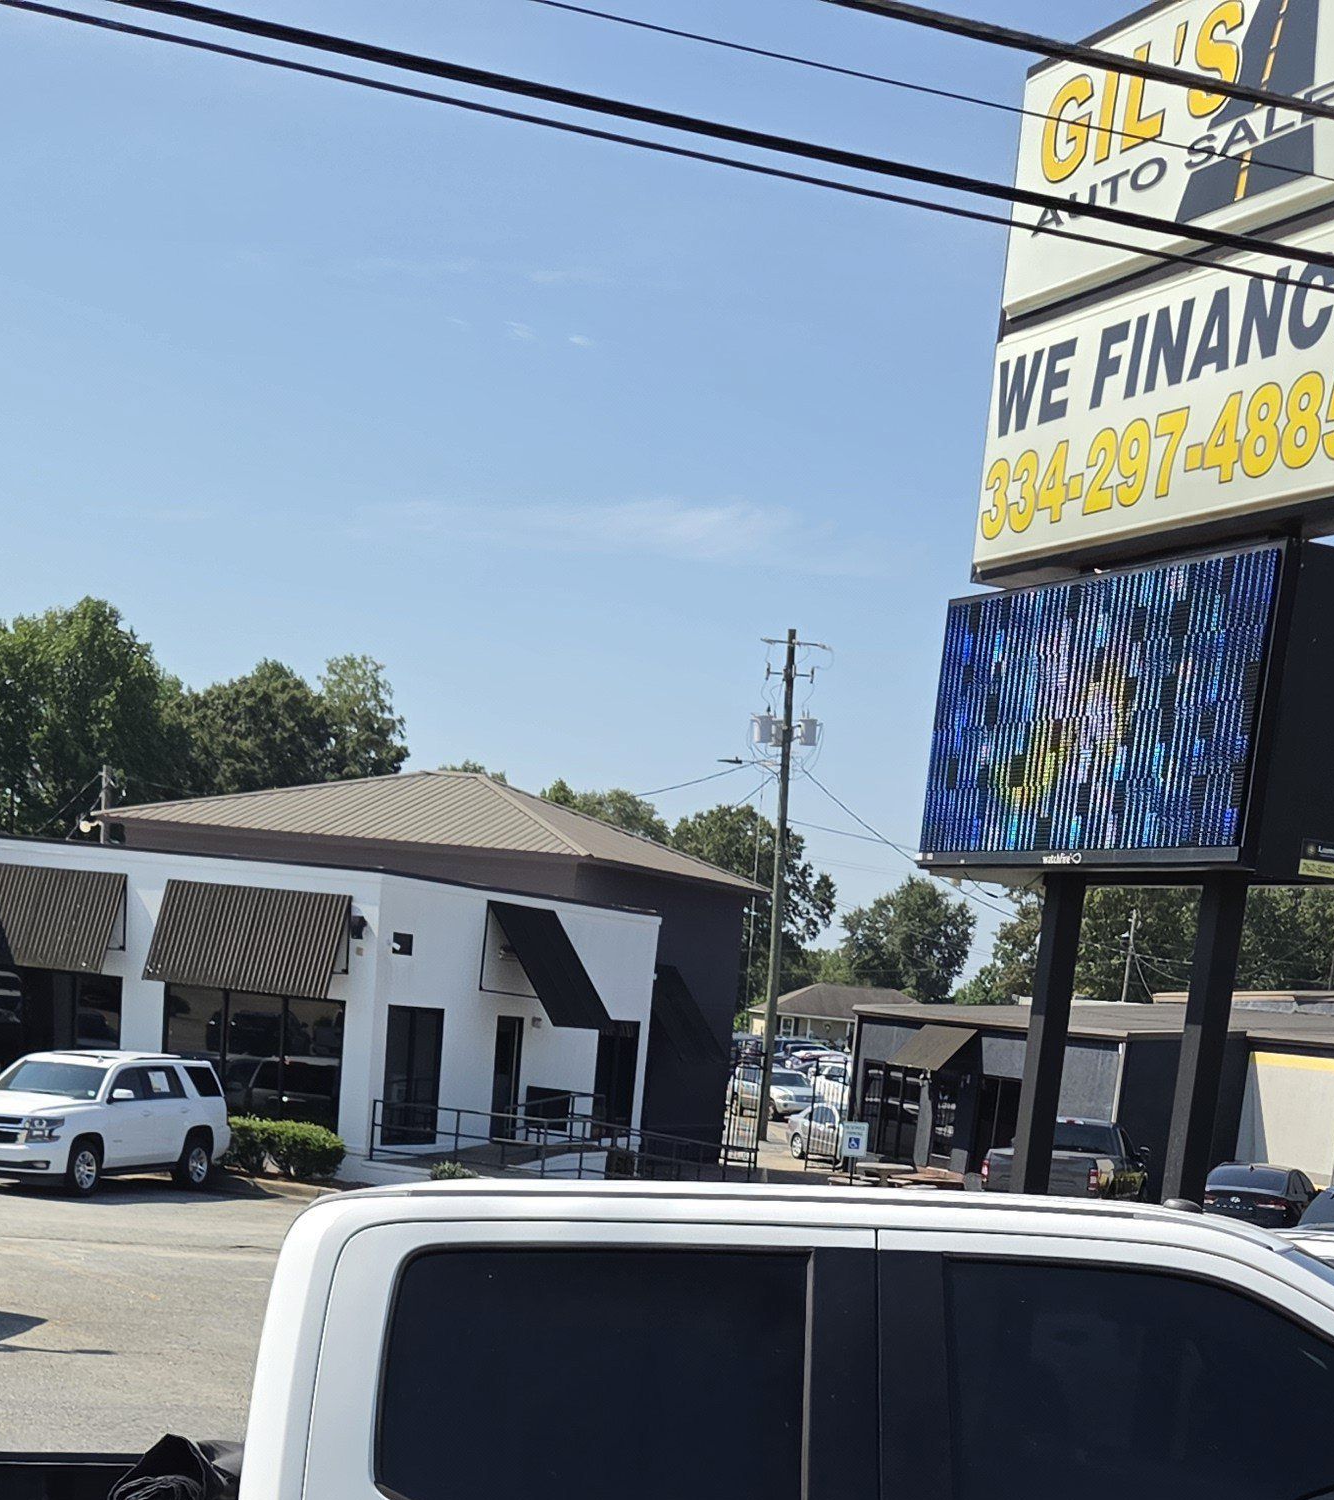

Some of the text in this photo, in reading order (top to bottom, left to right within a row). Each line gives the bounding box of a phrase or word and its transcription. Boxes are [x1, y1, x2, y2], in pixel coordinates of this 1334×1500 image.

[1041, 1, 1245, 184] GIL'S
[1031, 157, 1167, 236] AUTO
[998, 337, 1078, 439] WE
